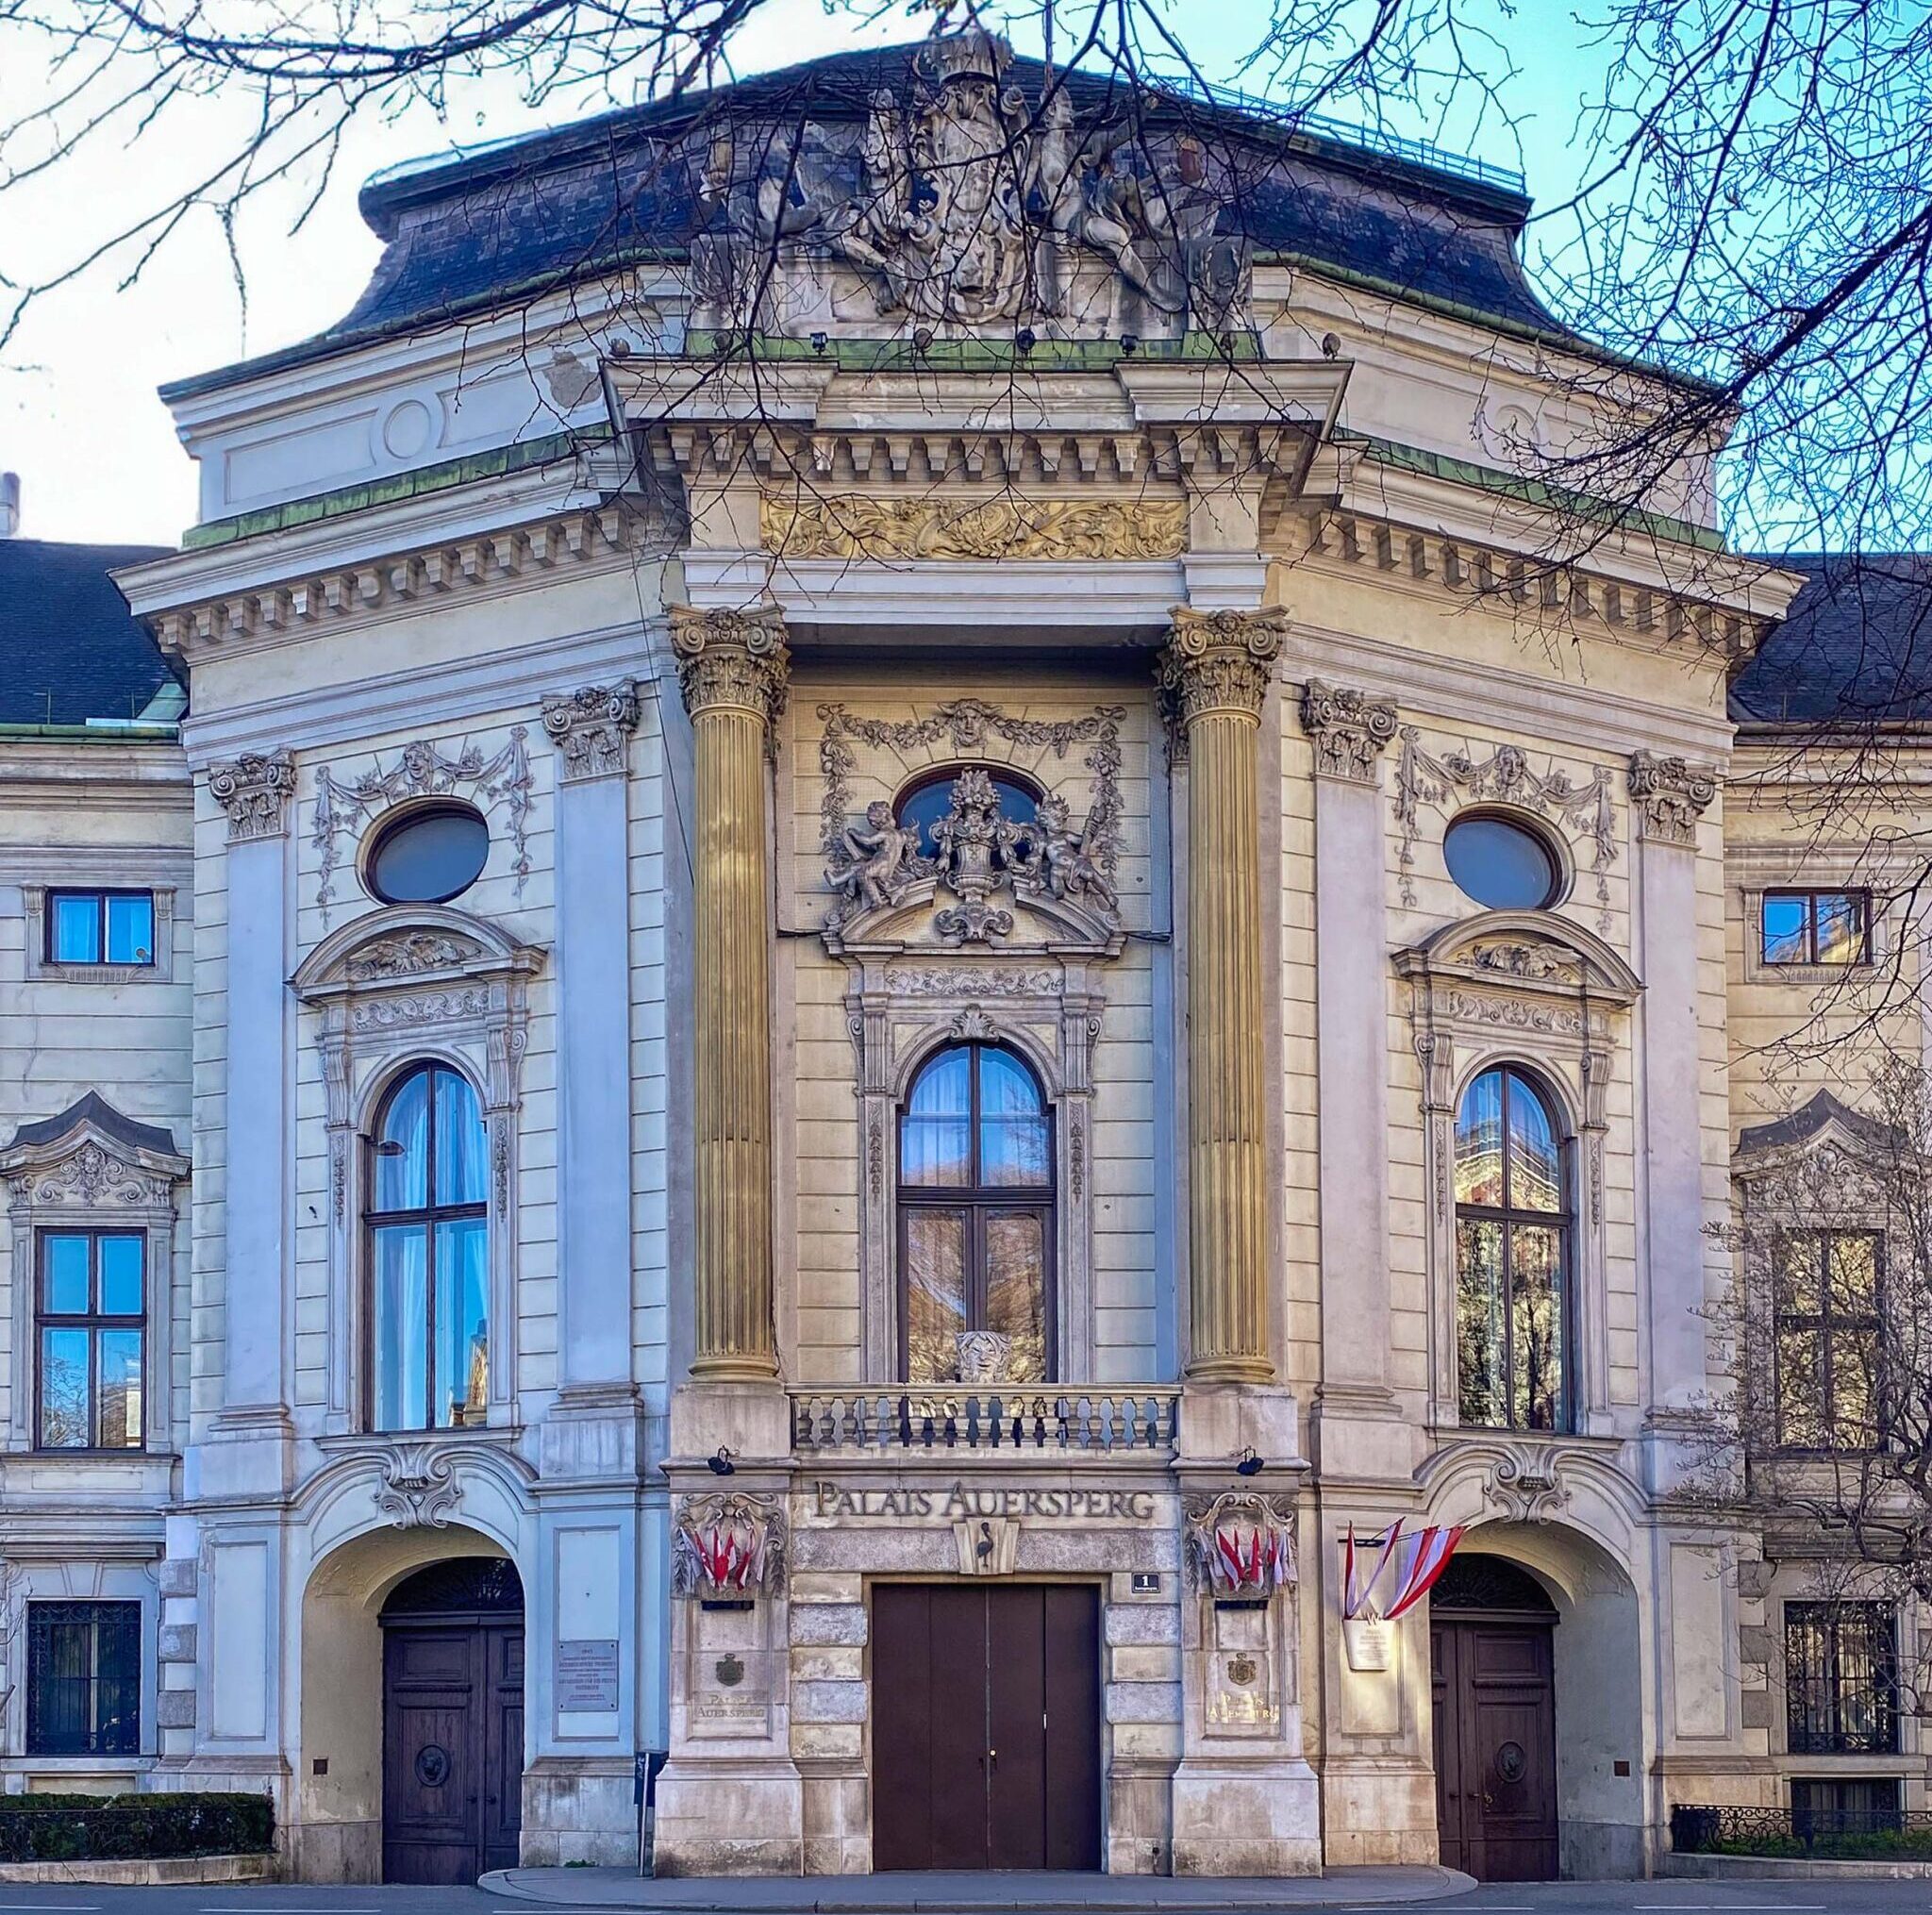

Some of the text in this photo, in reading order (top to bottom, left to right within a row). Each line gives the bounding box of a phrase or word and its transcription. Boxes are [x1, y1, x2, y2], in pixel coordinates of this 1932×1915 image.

[814, 1479, 1156, 1519] PALAIS AUERSPERG
[1141, 1574, 1149, 1587] 1
